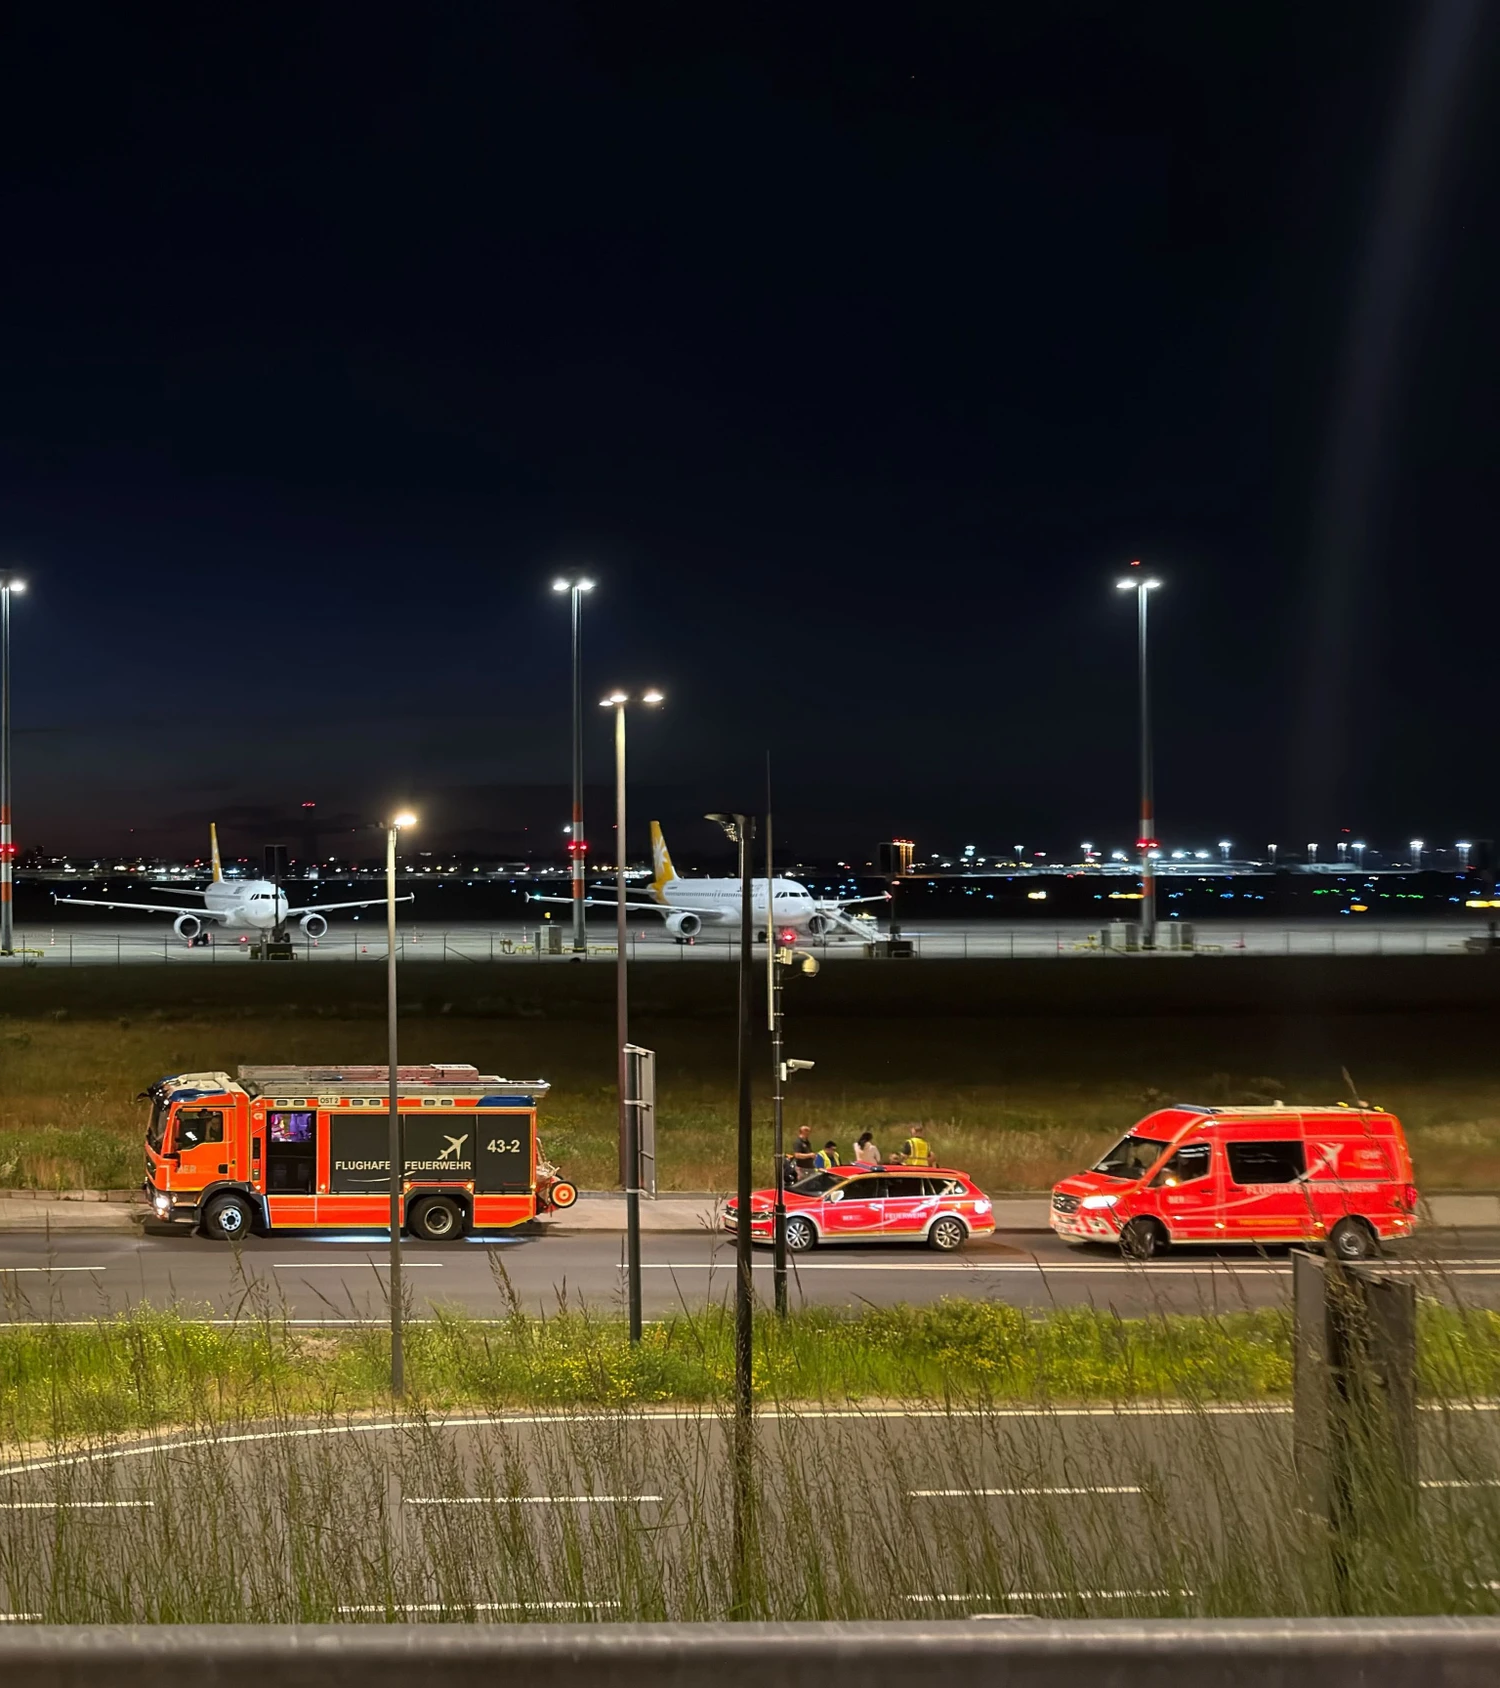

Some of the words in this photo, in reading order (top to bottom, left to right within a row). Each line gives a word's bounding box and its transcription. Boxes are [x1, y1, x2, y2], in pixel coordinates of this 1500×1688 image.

[487, 1139, 520, 1153] 43-2
[335, 1161, 392, 1170] FLUGHAFE
[404, 1161, 472, 1170] FEUERWEHR
